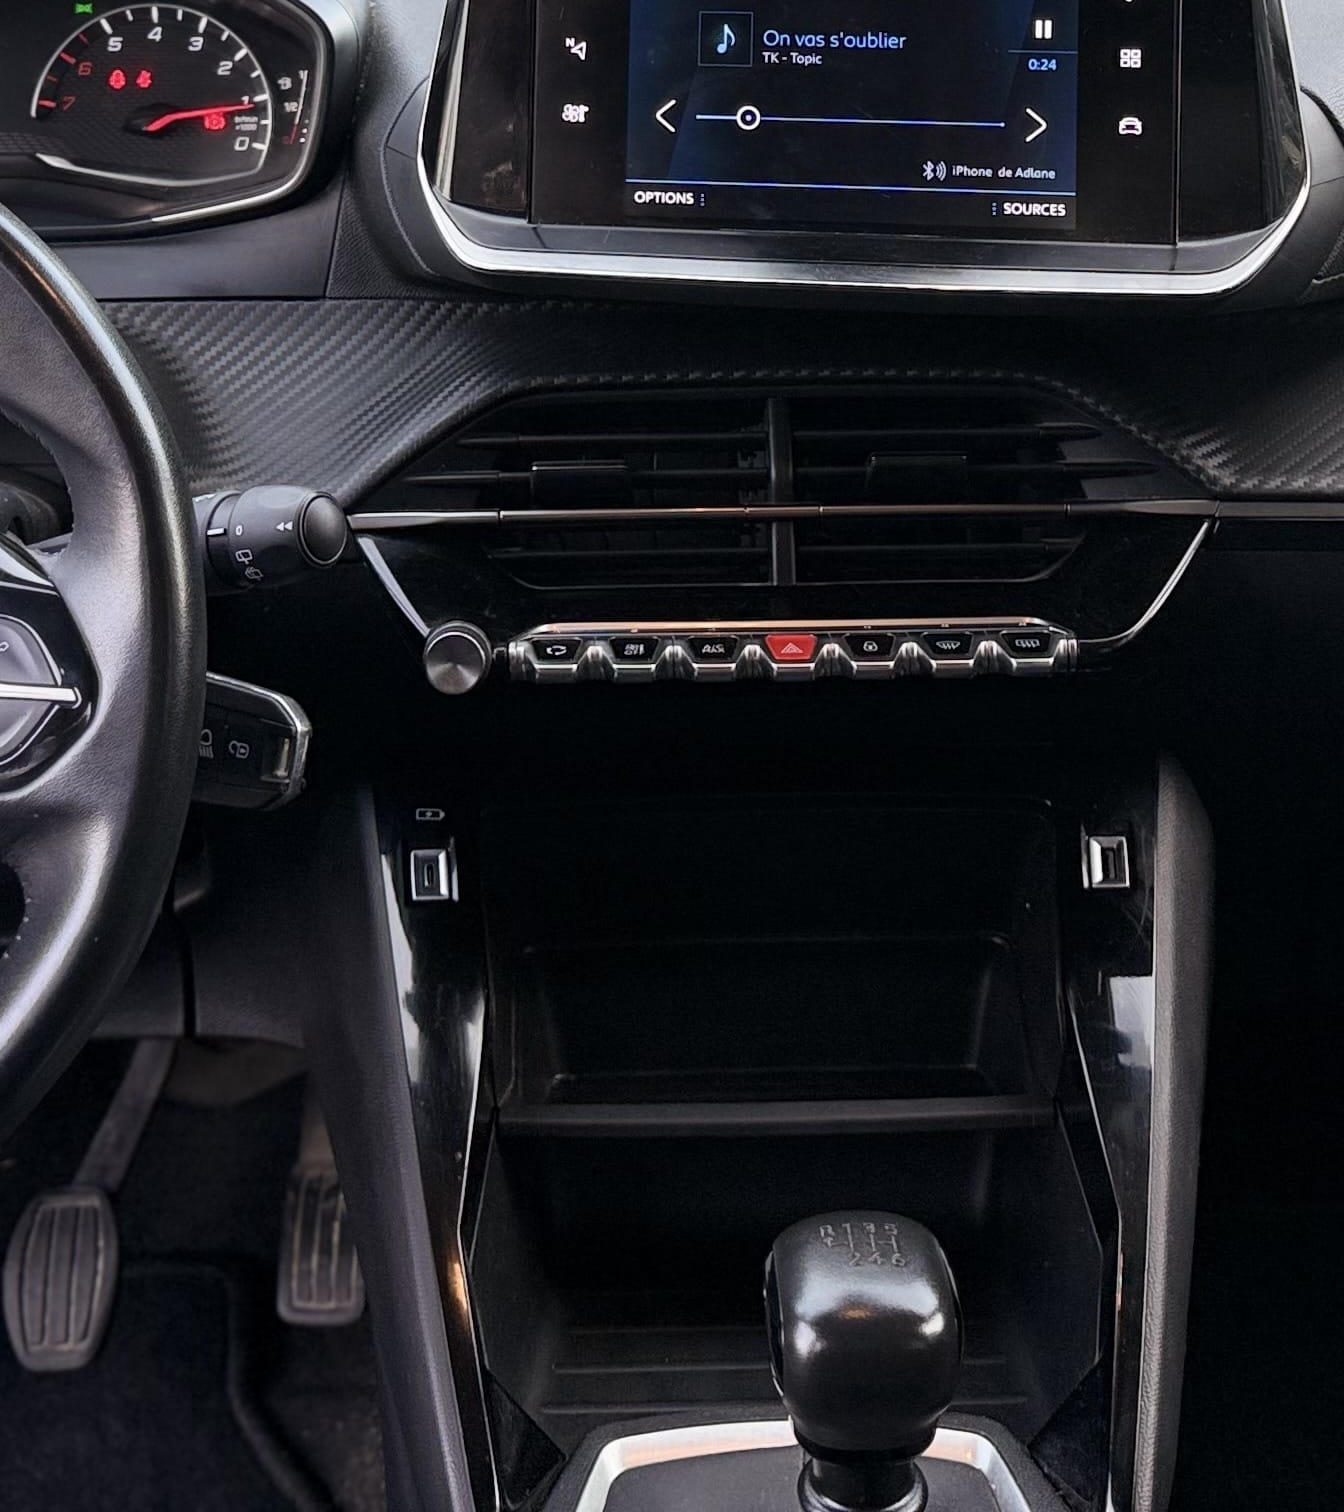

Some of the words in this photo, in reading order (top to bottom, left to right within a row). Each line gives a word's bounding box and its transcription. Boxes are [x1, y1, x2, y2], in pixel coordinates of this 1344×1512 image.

[147, 26, 163, 42] 4
[763, 29, 790, 47] On
[795, 36, 825, 48] vas
[829, 30, 906, 50] s'oublier
[107, 37, 124, 52] 5
[188, 38, 204, 52] 3
[762, 52, 780, 64] TK
[790, 53, 822, 67] Topic
[1028, 58, 1057, 71] 0:24
[77, 62, 92, 76] 6
[217, 60, 233, 76] 2
[62, 96, 76, 112] 7
[234, 136, 250, 151] 0
[952, 165, 993, 178] iPhone
[998, 166, 1013, 178] de
[1015, 167, 1056, 179] Adlane
[634, 191, 695, 206] OPTIONS
[1003, 202, 1067, 217] SOURCES
[850, 1252, 863, 1266] 2
[870, 1252, 884, 1266] 4
[891, 1252, 906, 1267] 6
